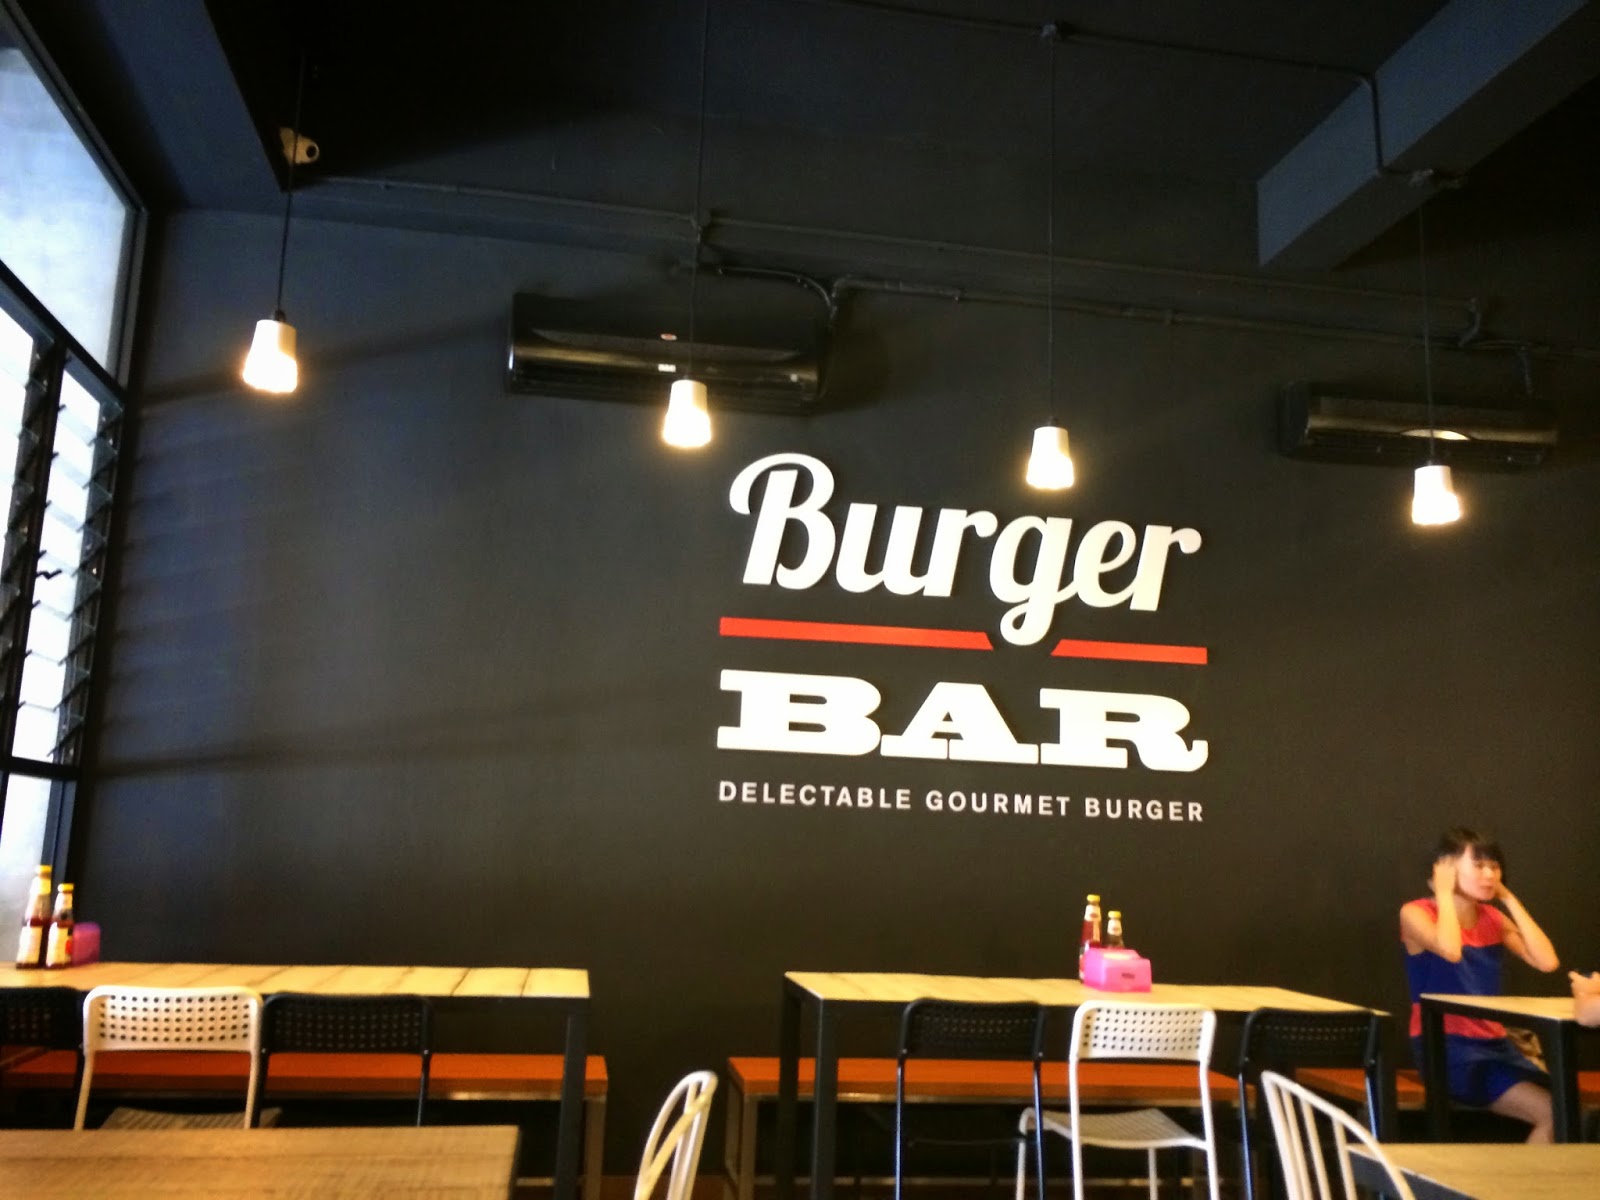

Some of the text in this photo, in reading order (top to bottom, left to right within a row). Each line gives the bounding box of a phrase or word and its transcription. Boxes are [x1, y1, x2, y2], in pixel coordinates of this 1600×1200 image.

[728, 452, 1202, 647] Burger
[716, 668, 1209, 773] BAR
[718, 780, 1204, 822] DELECTABLE GOURMET BURGER
